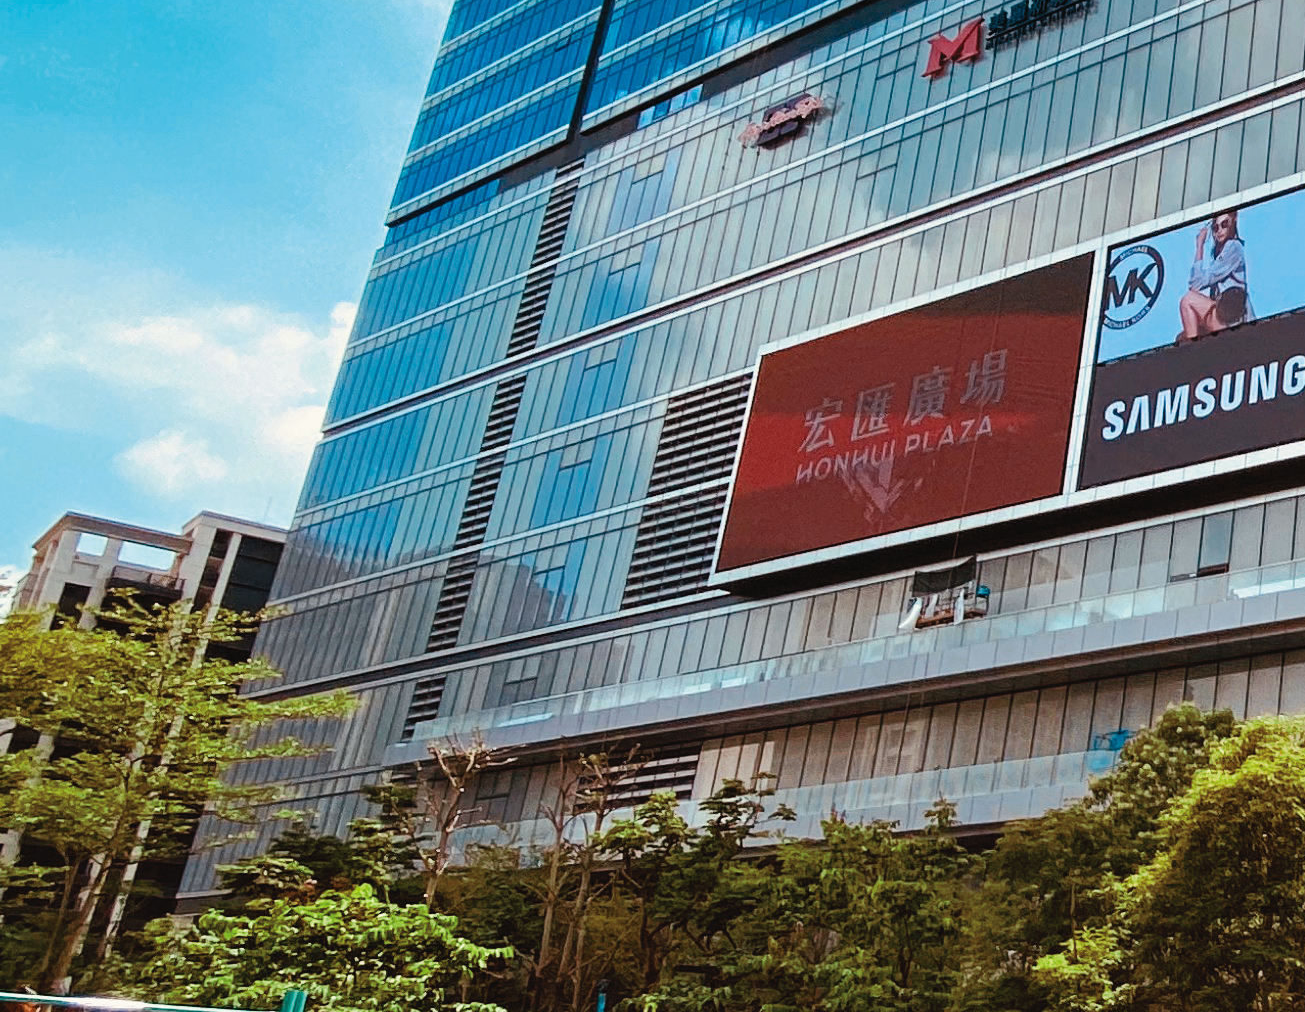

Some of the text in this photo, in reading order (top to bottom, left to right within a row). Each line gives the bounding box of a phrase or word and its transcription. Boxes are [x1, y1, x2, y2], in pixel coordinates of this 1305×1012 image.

[921, 16, 986, 79] M
[1103, 261, 1157, 309] MK
[797, 348, 1009, 454] 宏匯廣場
[794, 415, 994, 485] HONHUI PLAZA
